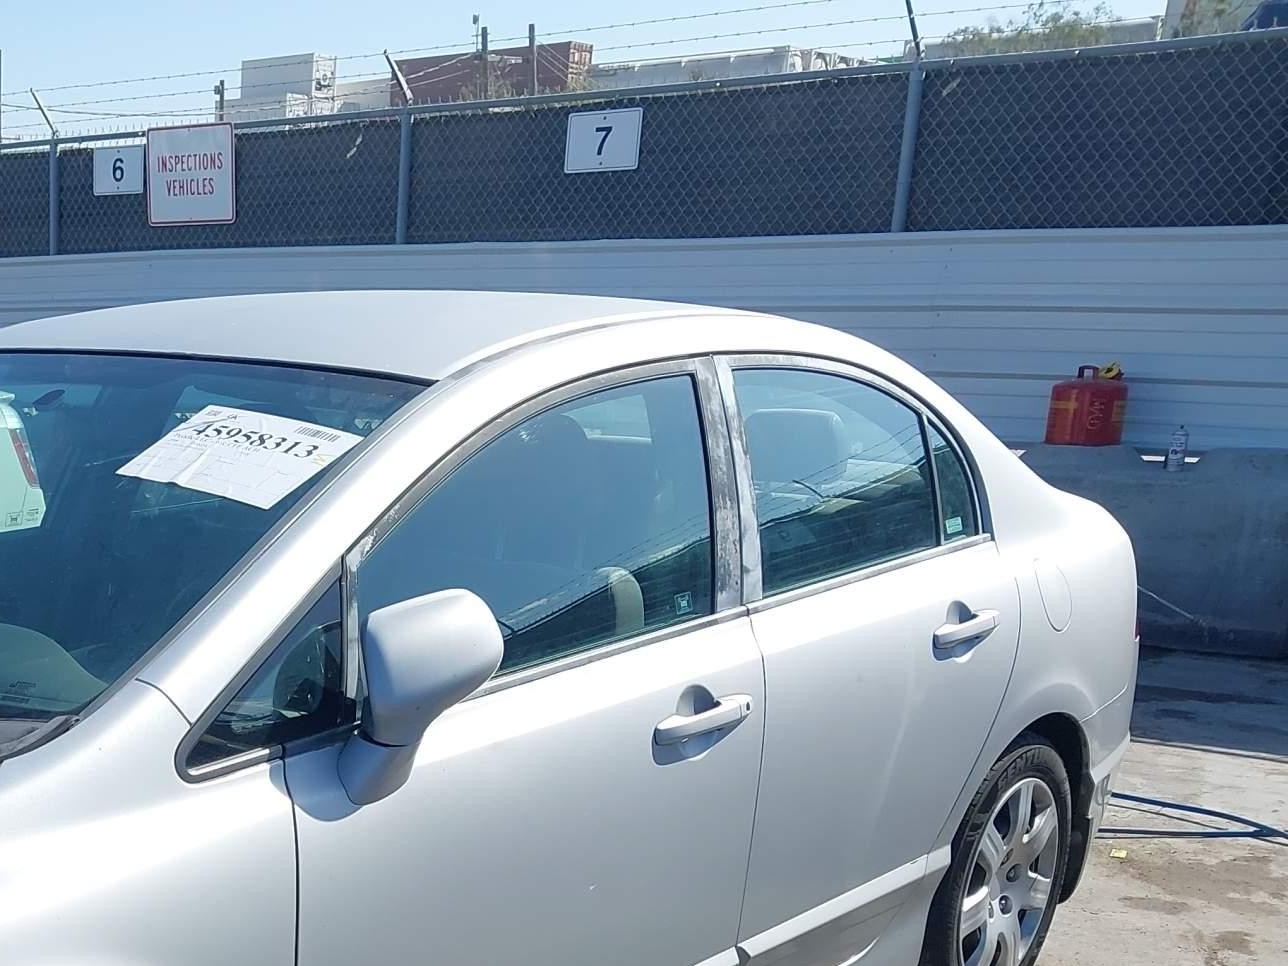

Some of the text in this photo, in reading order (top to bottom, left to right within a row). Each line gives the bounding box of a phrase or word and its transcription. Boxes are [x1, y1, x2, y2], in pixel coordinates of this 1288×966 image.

[595, 126, 613, 156] 7
[112, 157, 124, 183] 6
[157, 151, 224, 174] INSPECTIONS
[166, 177, 215, 197] VEHICLES
[192, 421, 320, 459] 45958313
